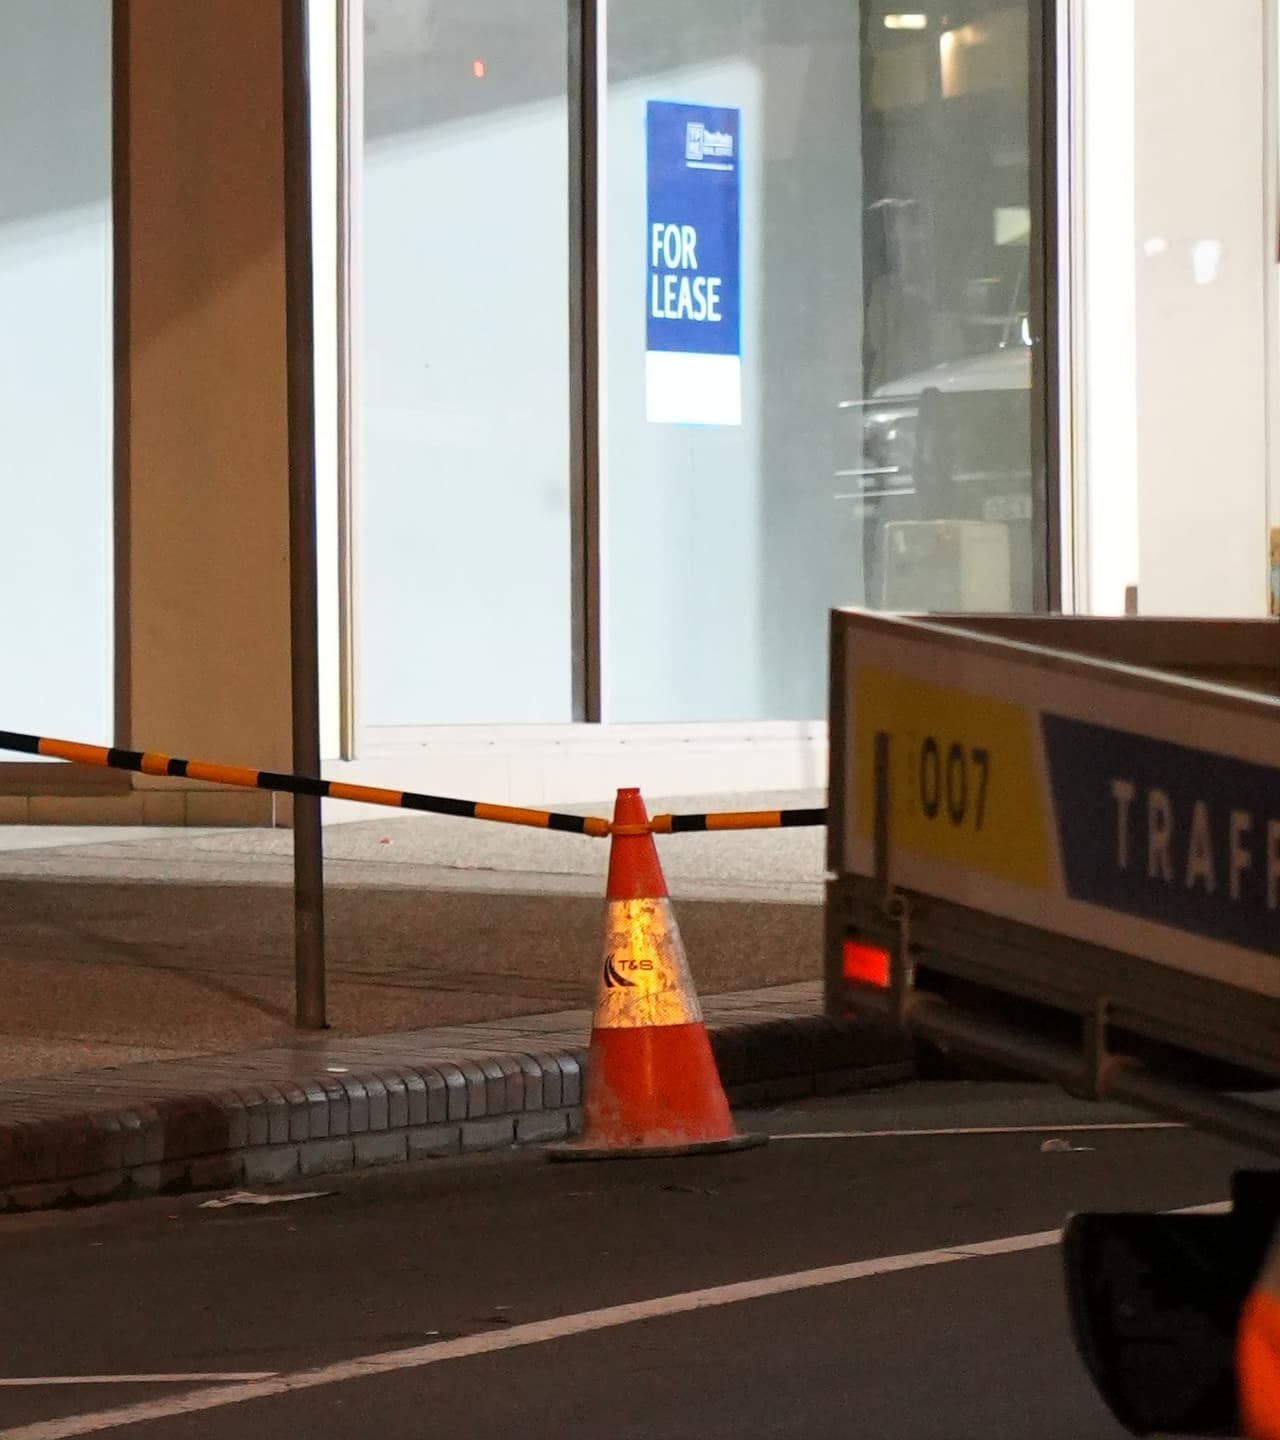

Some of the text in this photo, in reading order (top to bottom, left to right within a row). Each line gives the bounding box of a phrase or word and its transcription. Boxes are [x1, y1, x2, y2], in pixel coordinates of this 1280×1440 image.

[651, 222, 698, 270] FOR
[651, 273, 722, 322] LEASE
[919, 735, 990, 833] 007
[618, 959, 654, 971] T&S
